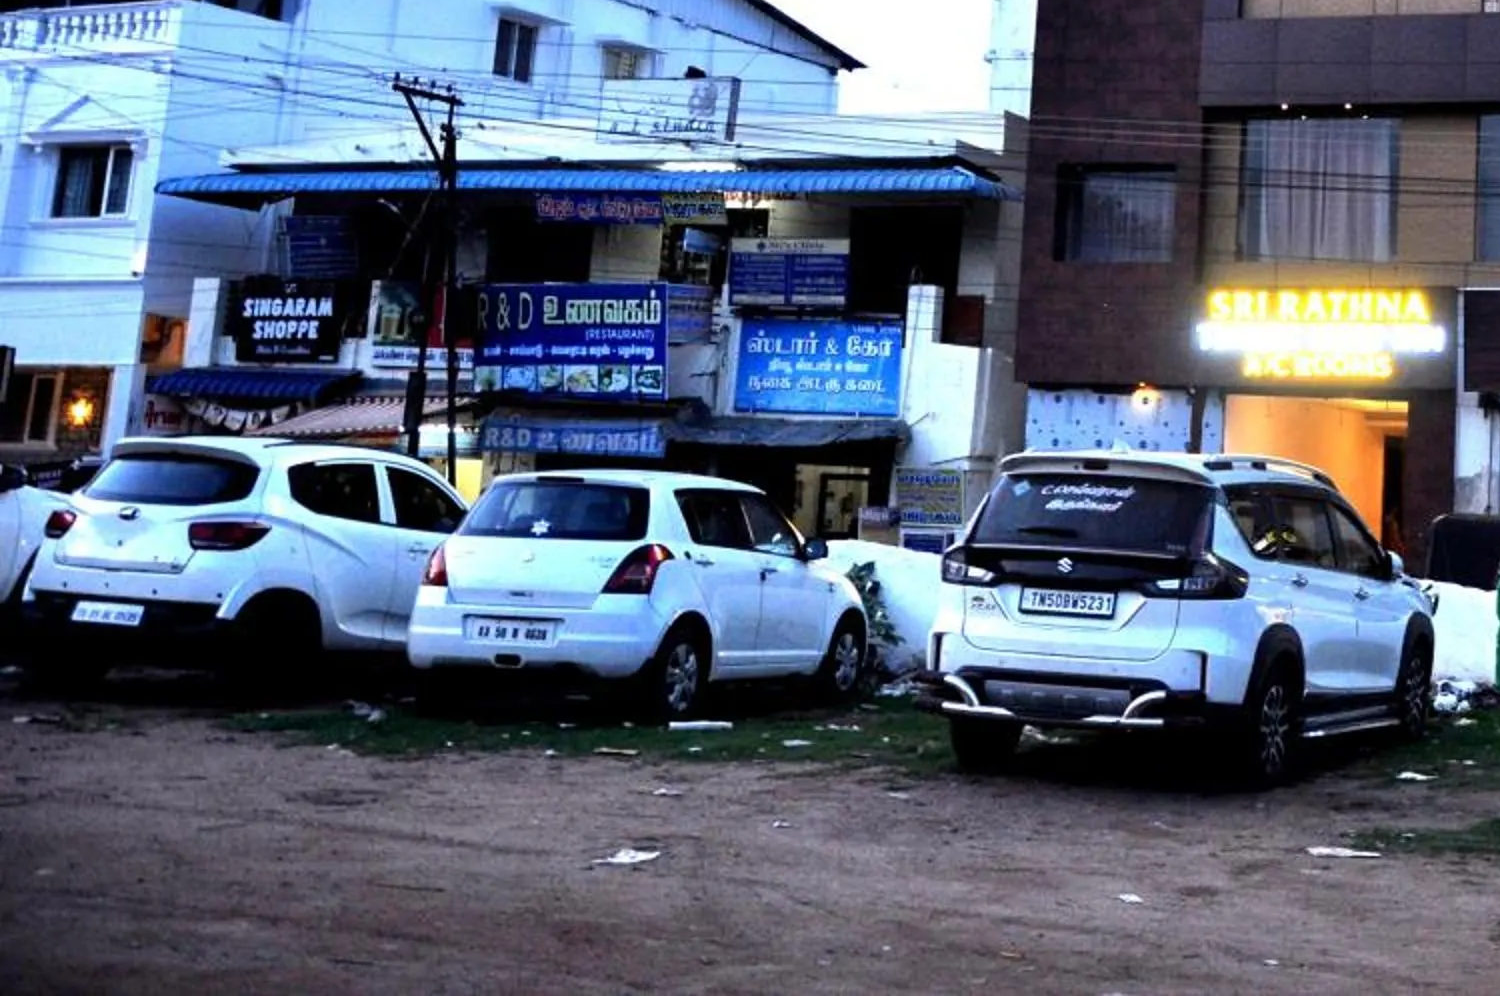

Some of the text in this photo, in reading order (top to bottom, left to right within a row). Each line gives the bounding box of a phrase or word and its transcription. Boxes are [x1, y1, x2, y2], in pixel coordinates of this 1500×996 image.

[242, 297, 333, 318] SINGARAM
[517, 290, 534, 330] D
[542, 288, 662, 326] உணவகம்
[1208, 288, 1430, 323] SRI RATHNA
[252, 319, 320, 340] SHOPPE
[484, 426, 531, 448] R&D
